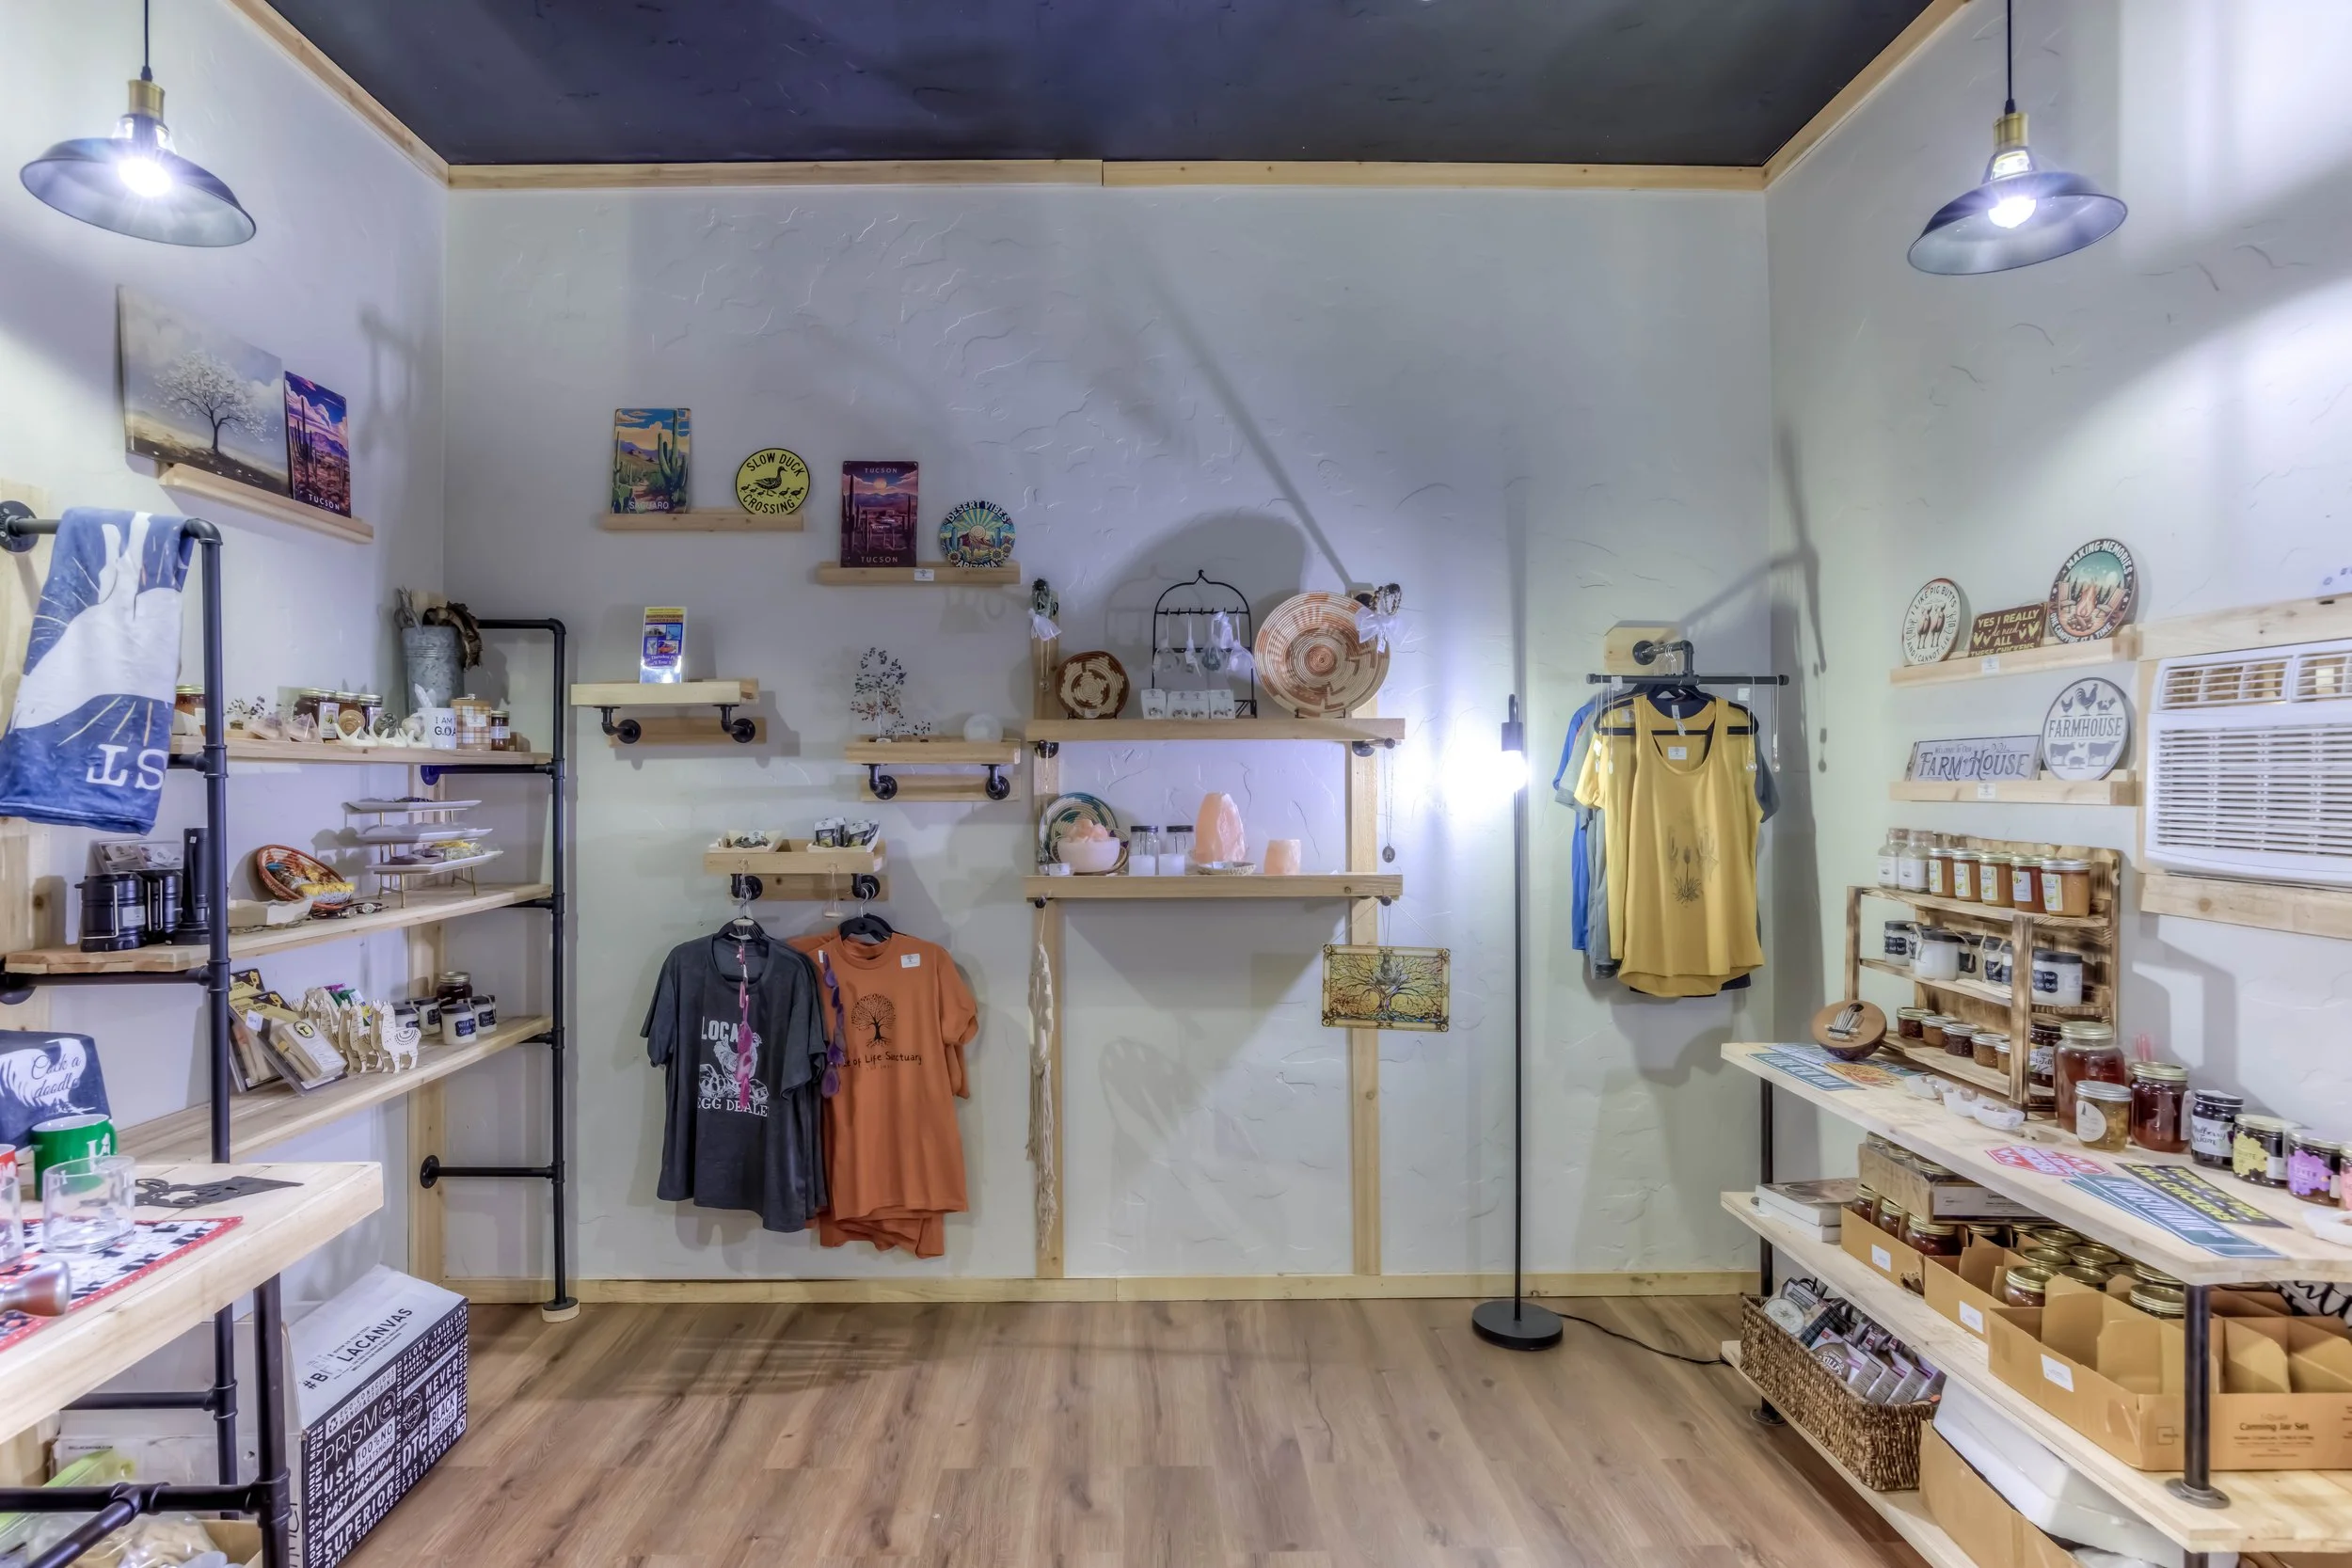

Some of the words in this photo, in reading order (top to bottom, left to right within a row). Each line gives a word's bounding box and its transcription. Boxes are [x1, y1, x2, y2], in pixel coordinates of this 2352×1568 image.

[746, 452, 775, 471] SLOW
[779, 453, 804, 477] DUCK
[309, 494, 340, 510] TUCSON
[628, 501, 669, 510] SAGUARO
[742, 494, 795, 514] CROSSING
[946, 499, 979, 523] DESERT
[984, 500, 1009, 523] VIBES
[2066, 541, 2101, 569] MAKING
[2104, 540, 2134, 575] MEMORIES
[1914, 591, 1929, 610] LIKE
[1930, 585, 1941, 594] PIG
[1941, 586, 1957, 608] BUTTS
[1979, 617, 1994, 628] YES
[1996, 616, 2001, 626] I
[2003, 609, 2040, 625] REALLY
[2001, 621, 2020, 636] need
[2095, 622, 2113, 640] TIME
[1917, 649, 1940, 662] CANNOT
[1971, 648, 1994, 657] THESE
[1995, 642, 2035, 654] CHICKENS
[1994, 636, 2012, 648] ALL
[2048, 717, 2123, 737] FARMHOUSE
[1920, 752, 1961, 781] FARM
[1965, 749, 2029, 781] HOUSE
[701, 1016, 739, 1042] LOCA
[71, 1056, 81, 1067] a
[852, 1058, 861, 1068] of
[865, 1053, 882, 1066] Life
[34, 1072, 81, 1099] doodle
[698, 1097, 722, 1110] EGG
[726, 1099, 770, 1117] DEALE
[2196, 1135, 2217, 1146] Jam
[2126, 1164, 2169, 1181] LOVE
[2160, 1181, 2238, 1222] CHICKENS
[430, 1323, 453, 1348] VINTAGE
[433, 1304, 467, 1339] TRIBLEND
[304, 1308, 413, 1389] #BLACANVAS
[340, 1367, 394, 1418] ECO-CONSCIOUS
[425, 1356, 457, 1400] NEVER
[425, 1372, 457, 1413] TUBULAR
[340, 1374, 394, 1425] MANUFACTURING
[402, 1399, 422, 1423] AIRLUME
[432, 1391, 453, 1427] BLACK
[431, 1406, 454, 1440] HEATHER
[2239, 1422, 2277, 1432] Canning
[2279, 1422, 2292, 1431] Jar
[2295, 1422, 2310, 1431] Set
[309, 1428, 317, 1463] MADE
[323, 1403, 377, 1473] PRISM
[402, 1425, 427, 1470] DTG
[402, 1461, 417, 1484] LOS
[422, 1421, 456, 1464] ANGELES
[357, 1433, 392, 1473] SWEATSHOPS
[401, 1429, 456, 1494] CALIFORNIA
[314, 1457, 323, 1499] EVERY
[323, 1453, 354, 1497] USA
[324, 1485, 352, 1528] FAST
[351, 1446, 395, 1501] FASHION
[324, 1472, 354, 1507] STRONG
[309, 1515, 315, 1534] OF
[325, 1479, 393, 1563] SUPERIOR
[357, 1496, 393, 1541] SURFACE
